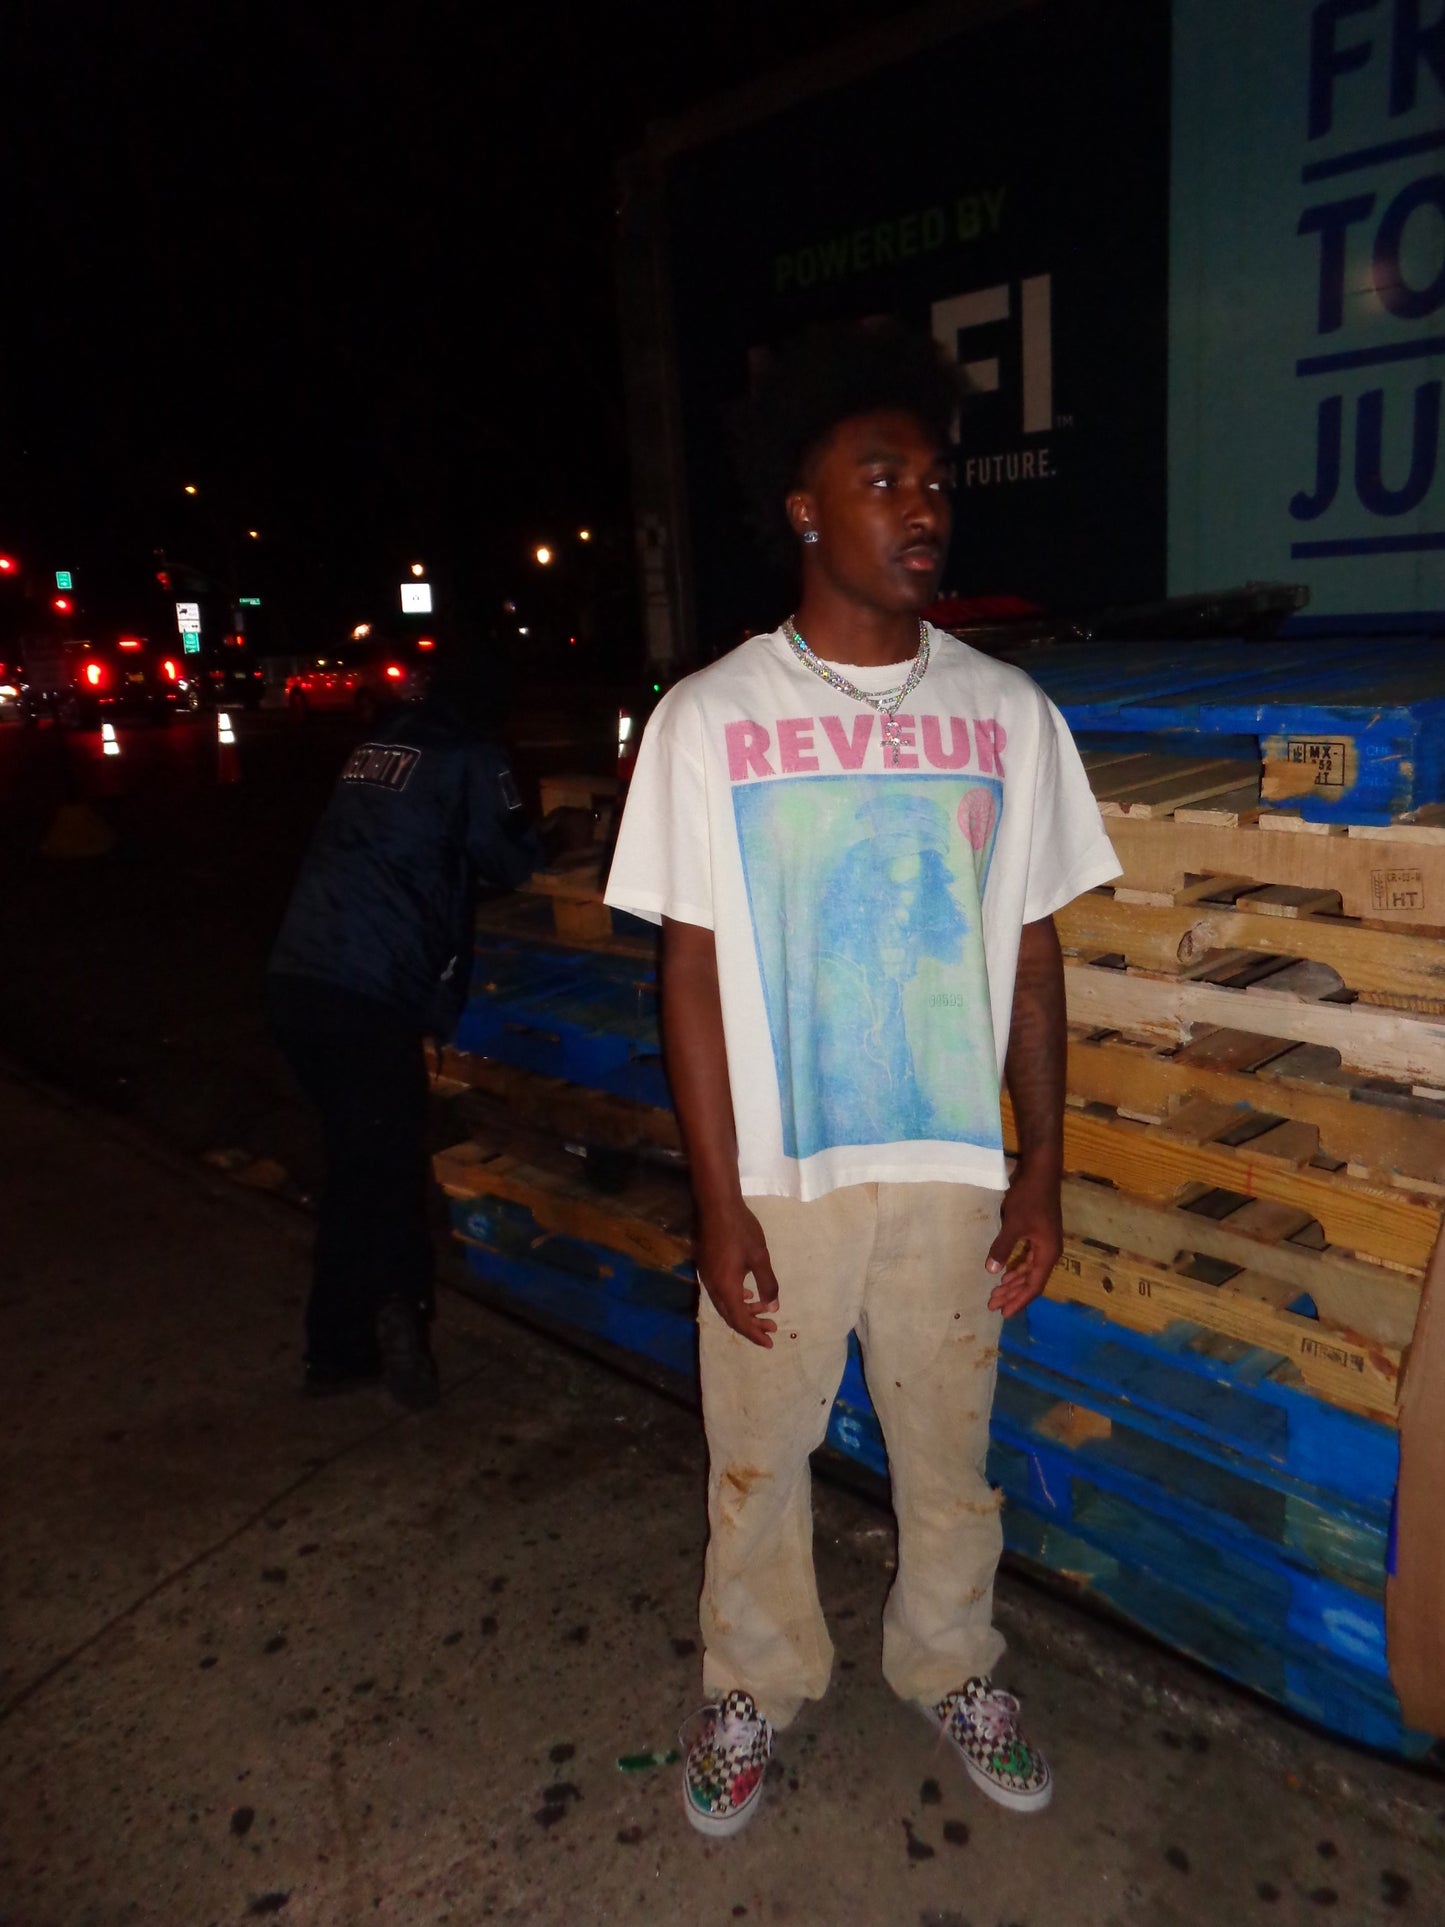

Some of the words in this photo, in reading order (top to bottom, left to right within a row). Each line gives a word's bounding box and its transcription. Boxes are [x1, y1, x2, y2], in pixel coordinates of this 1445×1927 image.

[775, 206, 947, 294] POWERED
[955, 184, 1008, 242] BY
[965, 449, 1058, 488] FUTURE.
[724, 713, 1008, 782] REVEUR
[1392, 891, 1419, 907] HT
